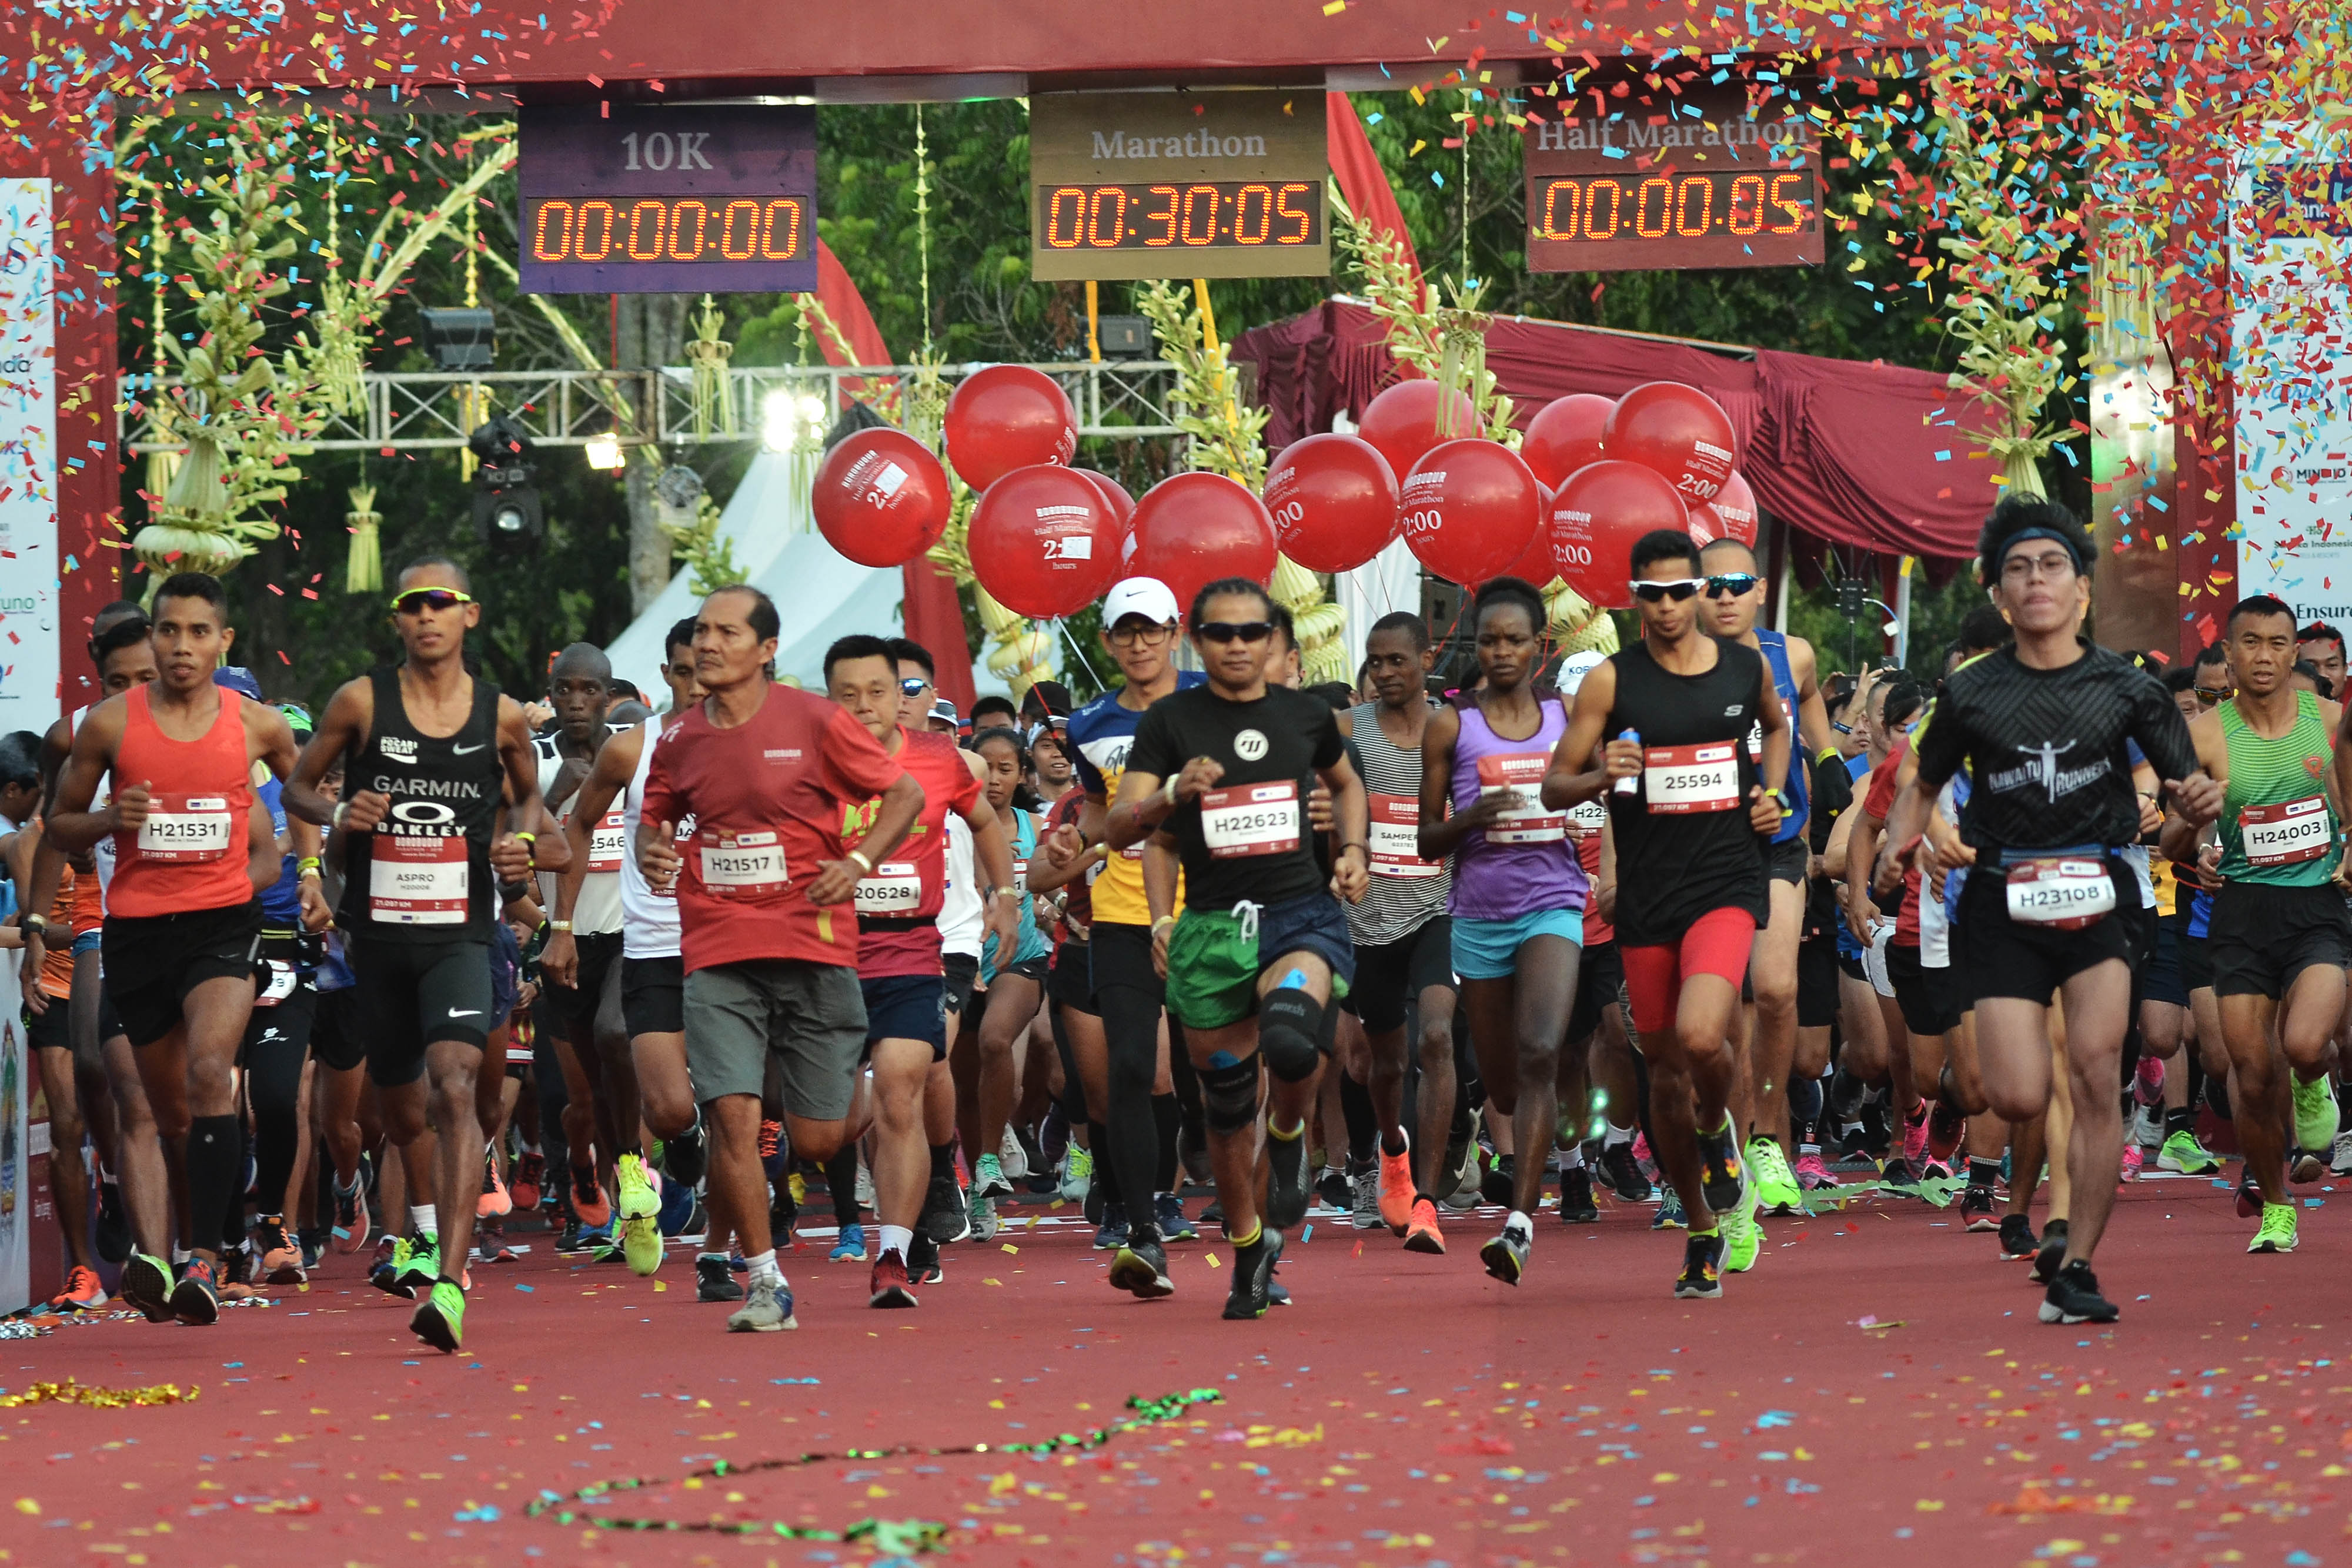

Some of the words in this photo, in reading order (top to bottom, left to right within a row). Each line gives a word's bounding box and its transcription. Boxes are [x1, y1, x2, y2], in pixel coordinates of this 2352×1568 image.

[1092, 127, 1267, 159] Marathon
[1538, 119, 1615, 151] Half
[1626, 117, 1808, 149] Marathon
[621, 132, 713, 171] 10K
[1048, 184, 1309, 248] 00:30:05
[535, 200, 800, 261] 00:00:00
[1676, 473, 1719, 499] 2:00
[1403, 510, 1442, 537] 2:00
[1552, 543, 1592, 566] 2:00
[380, 738, 419, 750] POCARI
[380, 746, 414, 754] SWEAT
[1665, 773, 1723, 789] 25594
[150, 823, 216, 837] H21531
[377, 822, 467, 837] OAKLEY
[1215, 812, 1289, 833] H22623
[2253, 821, 2321, 844] H24003
[711, 857, 770, 871] H21517
[396, 873, 435, 882] ASPRO
[855, 887, 910, 900] 20628
[2021, 886, 2099, 907] H23108
